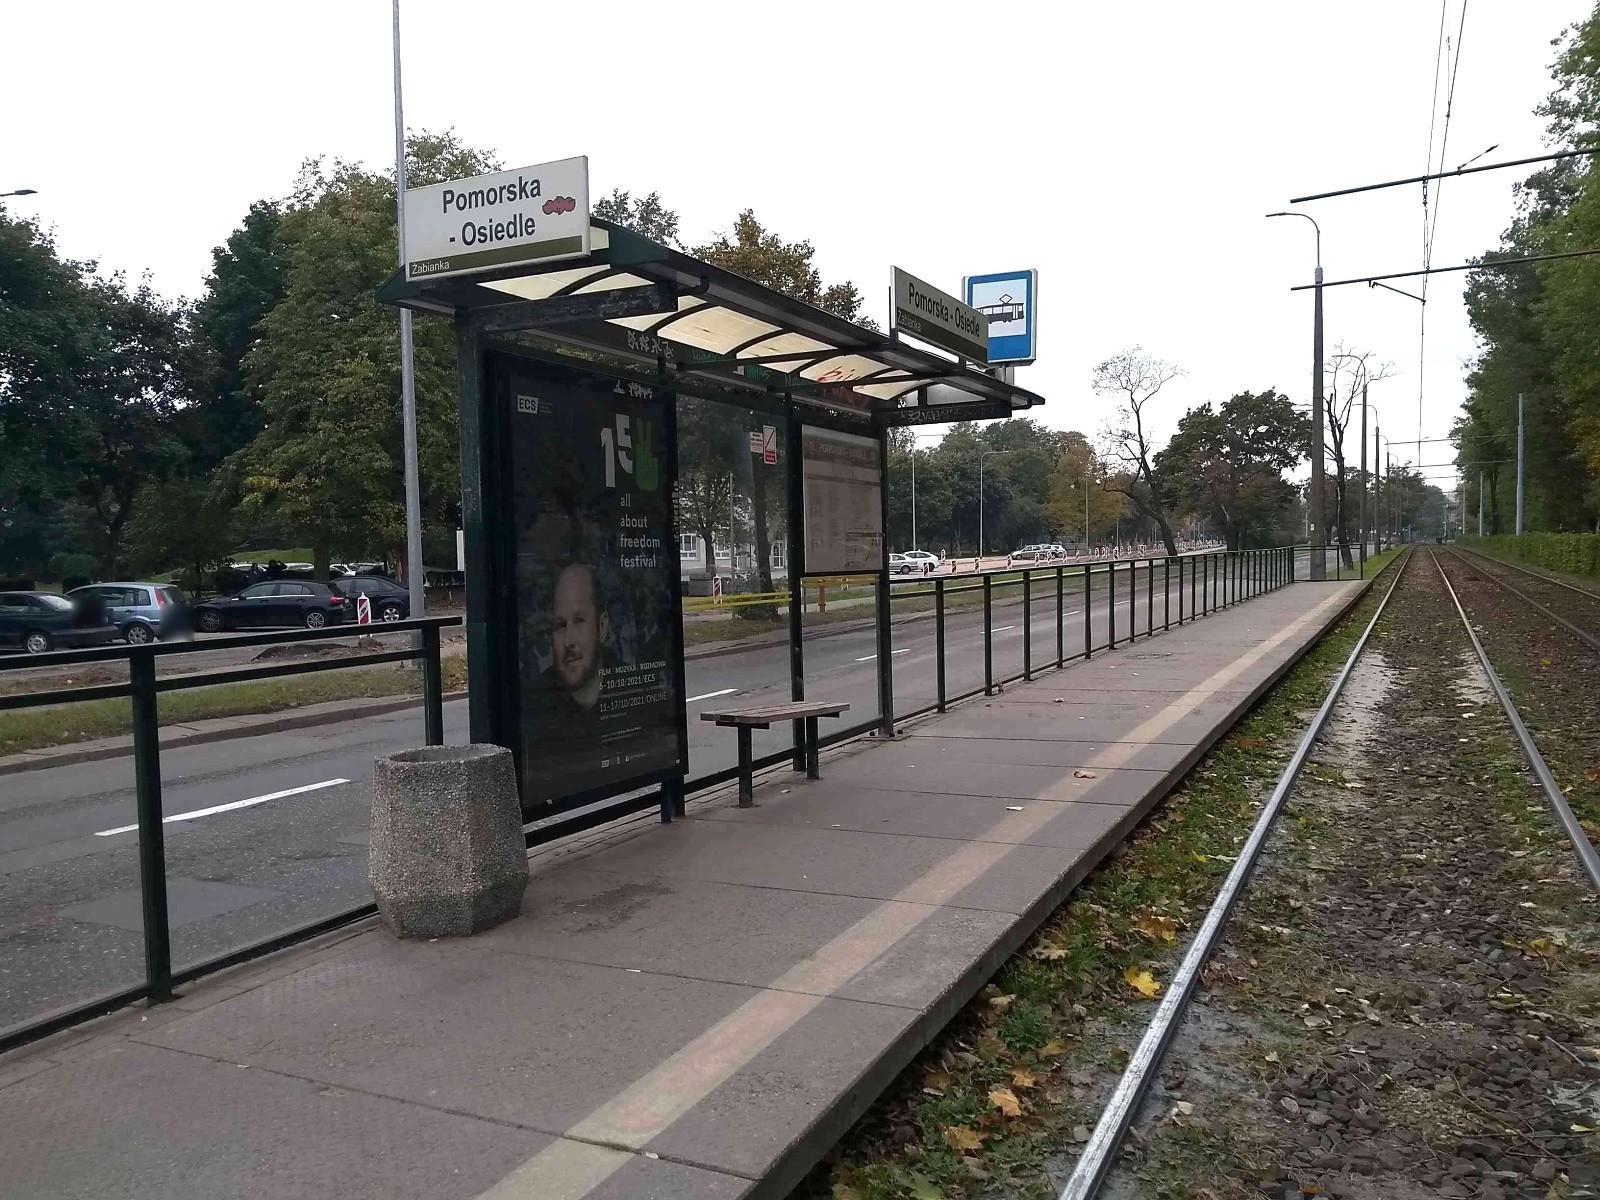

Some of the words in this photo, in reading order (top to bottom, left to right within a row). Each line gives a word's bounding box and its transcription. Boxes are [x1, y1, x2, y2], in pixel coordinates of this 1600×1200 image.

[443, 176, 541, 213] Pomorska
[461, 213, 536, 246] Osiedle
[908, 282, 949, 322] Pomorska
[954, 307, 980, 338] Osiedle
[519, 398, 536, 411] ECS
[600, 413, 633, 488] 15
[620, 493, 631, 508] all
[620, 516, 648, 528] about
[620, 534, 660, 549] freedom
[620, 554, 656, 568] festival
